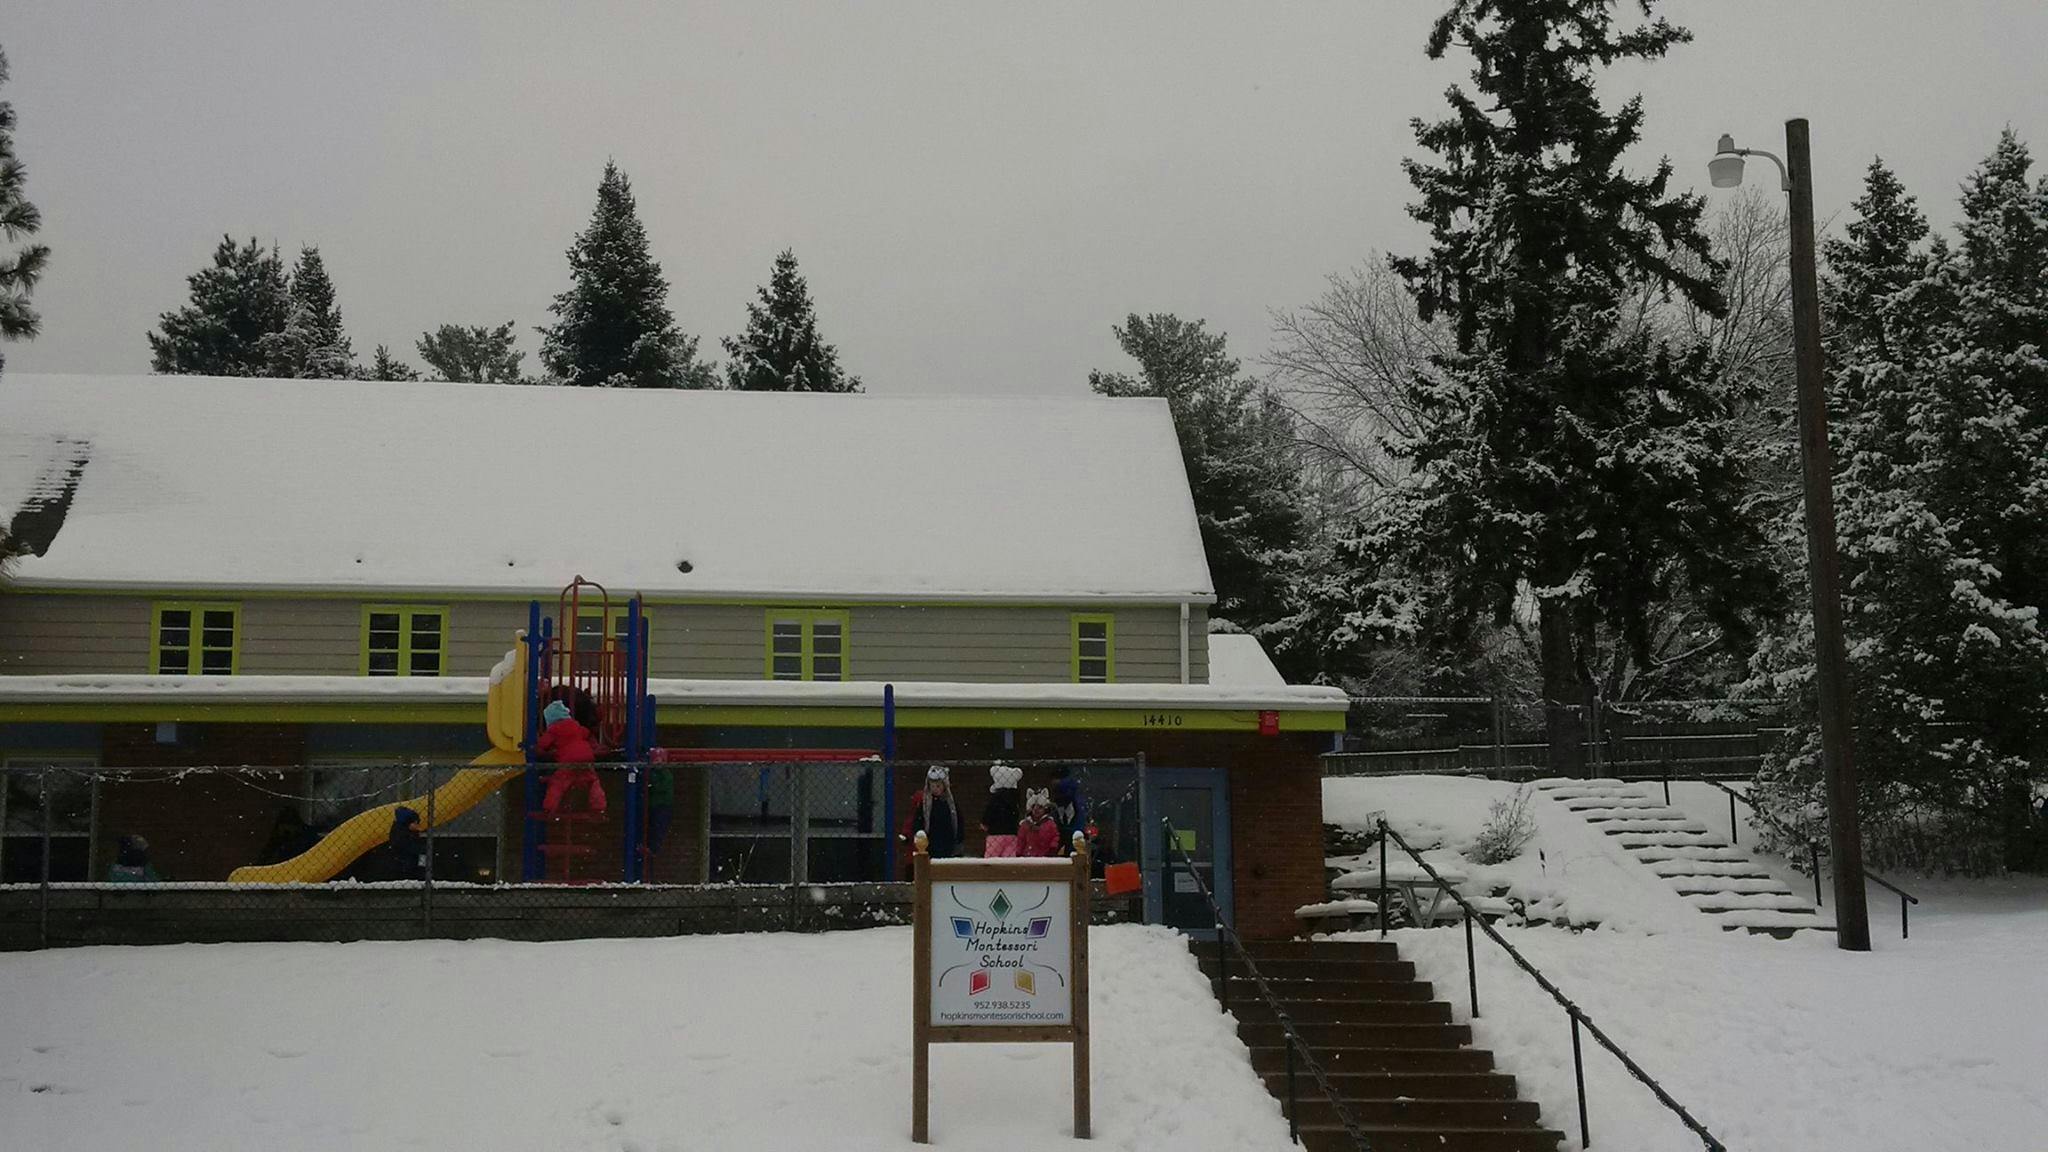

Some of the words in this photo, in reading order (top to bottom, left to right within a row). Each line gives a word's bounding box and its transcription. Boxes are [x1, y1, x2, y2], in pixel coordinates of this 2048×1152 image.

[1144, 715, 1182, 726] 14410
[975, 921, 1029, 939] Hopkins
[966, 939, 1038, 952] Montessori
[979, 955, 1024, 968] School
[974, 1001, 1031, 1010] 952.938.5235
[940, 1012, 1064, 1022] hopkinsmontessorischool.com
